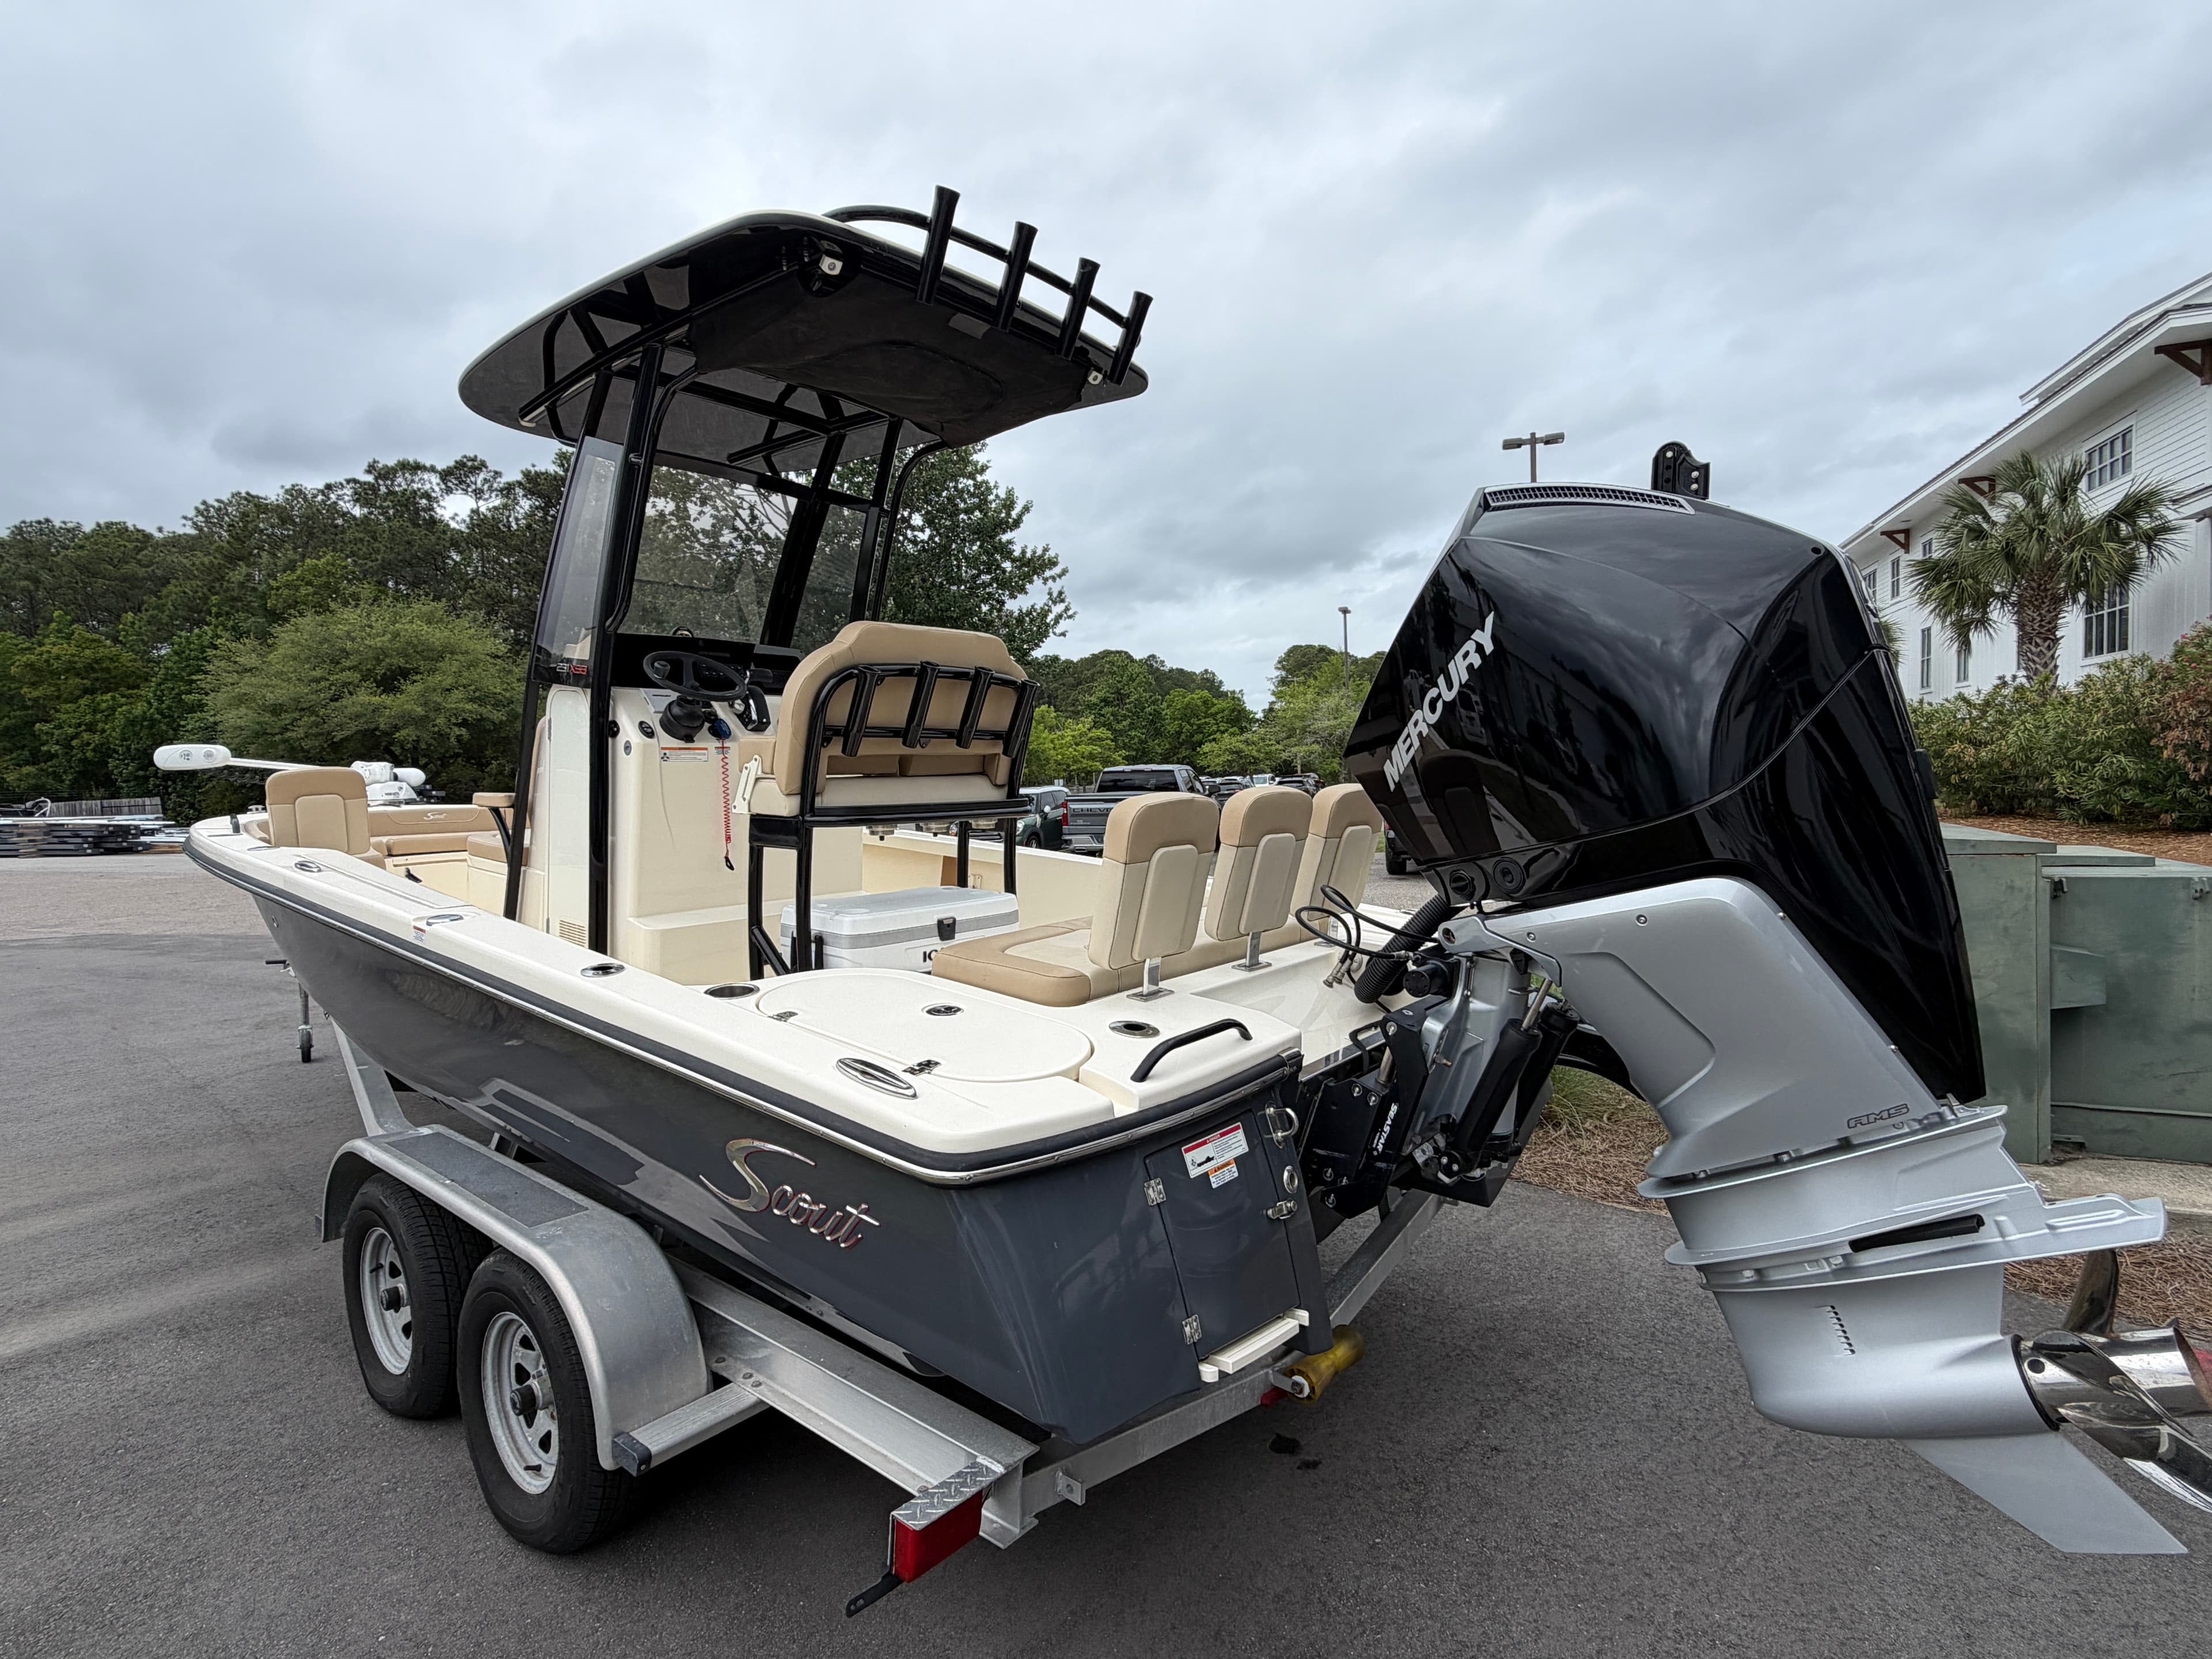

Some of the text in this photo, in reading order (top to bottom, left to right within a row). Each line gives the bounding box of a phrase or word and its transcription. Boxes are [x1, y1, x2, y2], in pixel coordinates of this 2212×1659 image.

[1383, 611, 1494, 792] MERCURY
[1377, 1103, 1398, 1154] SEASTAR
[1847, 1103, 1910, 1129] AMS
[699, 1138, 881, 1250] Scout
